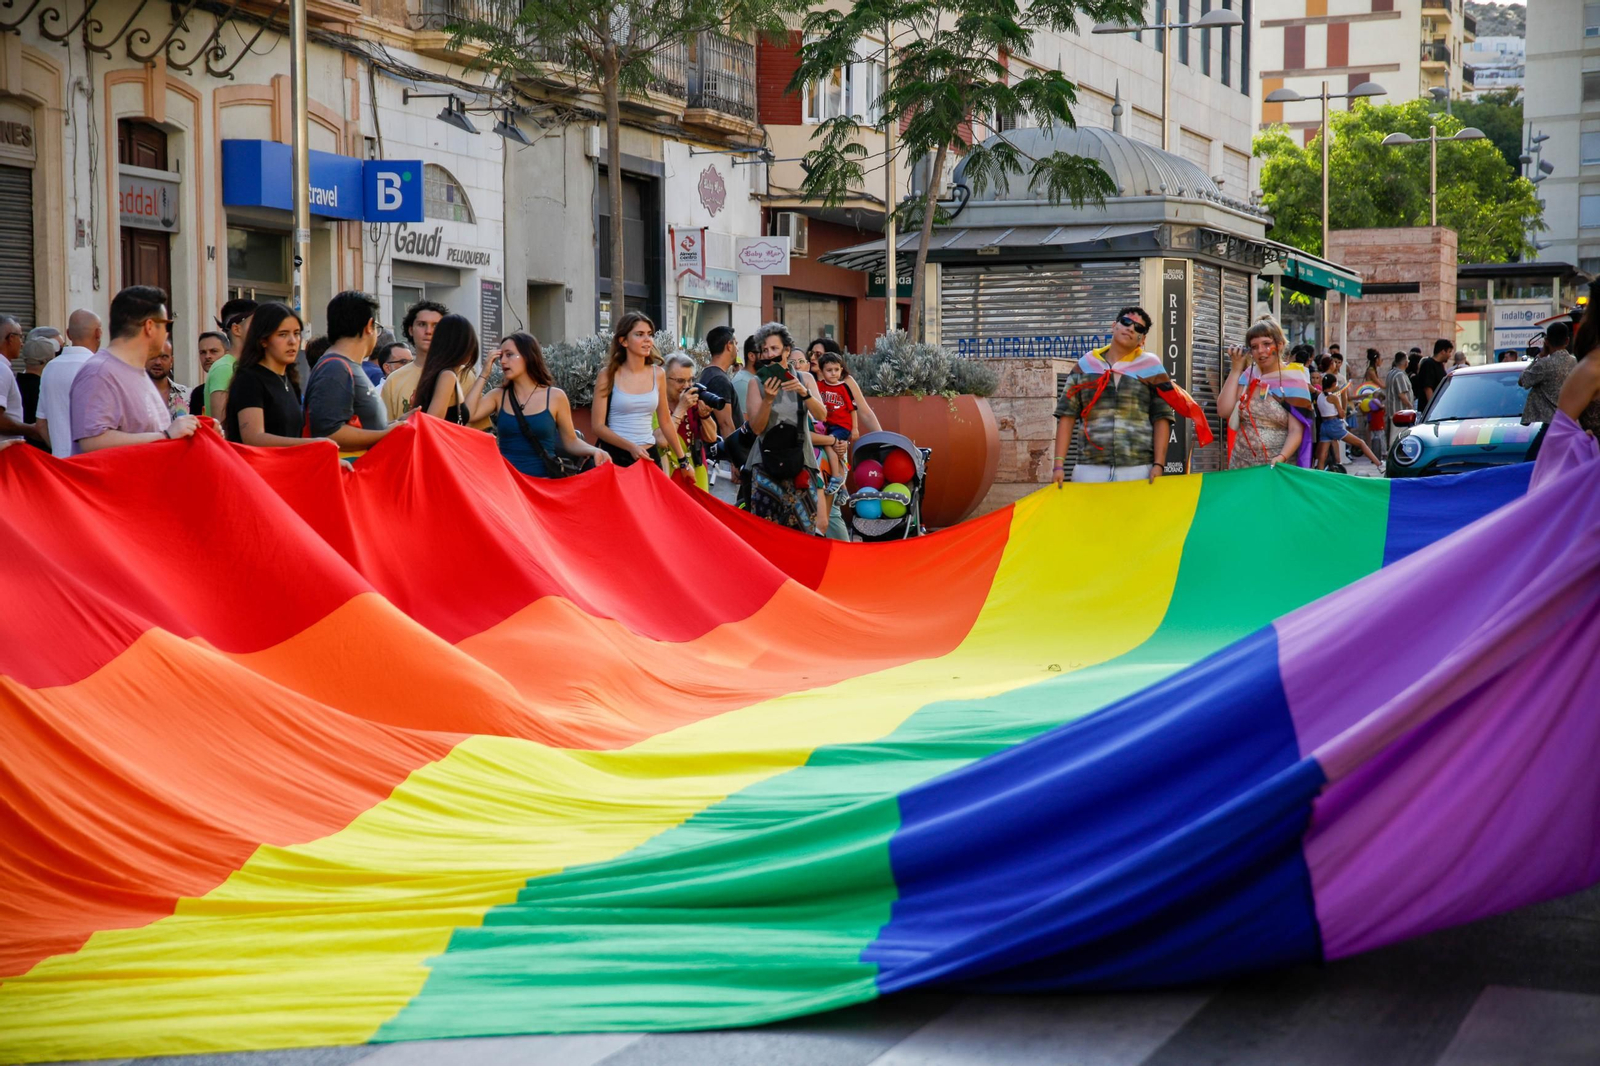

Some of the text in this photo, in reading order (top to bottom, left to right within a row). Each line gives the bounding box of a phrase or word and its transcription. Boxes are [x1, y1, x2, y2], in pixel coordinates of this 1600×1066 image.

[308, 183, 338, 207] travel
[207, 245, 215, 261] 14
[447, 248, 490, 265] PELUQUERIA
[744, 250, 763, 259] Baby
[1168, 294, 1178, 443] RELOJA
